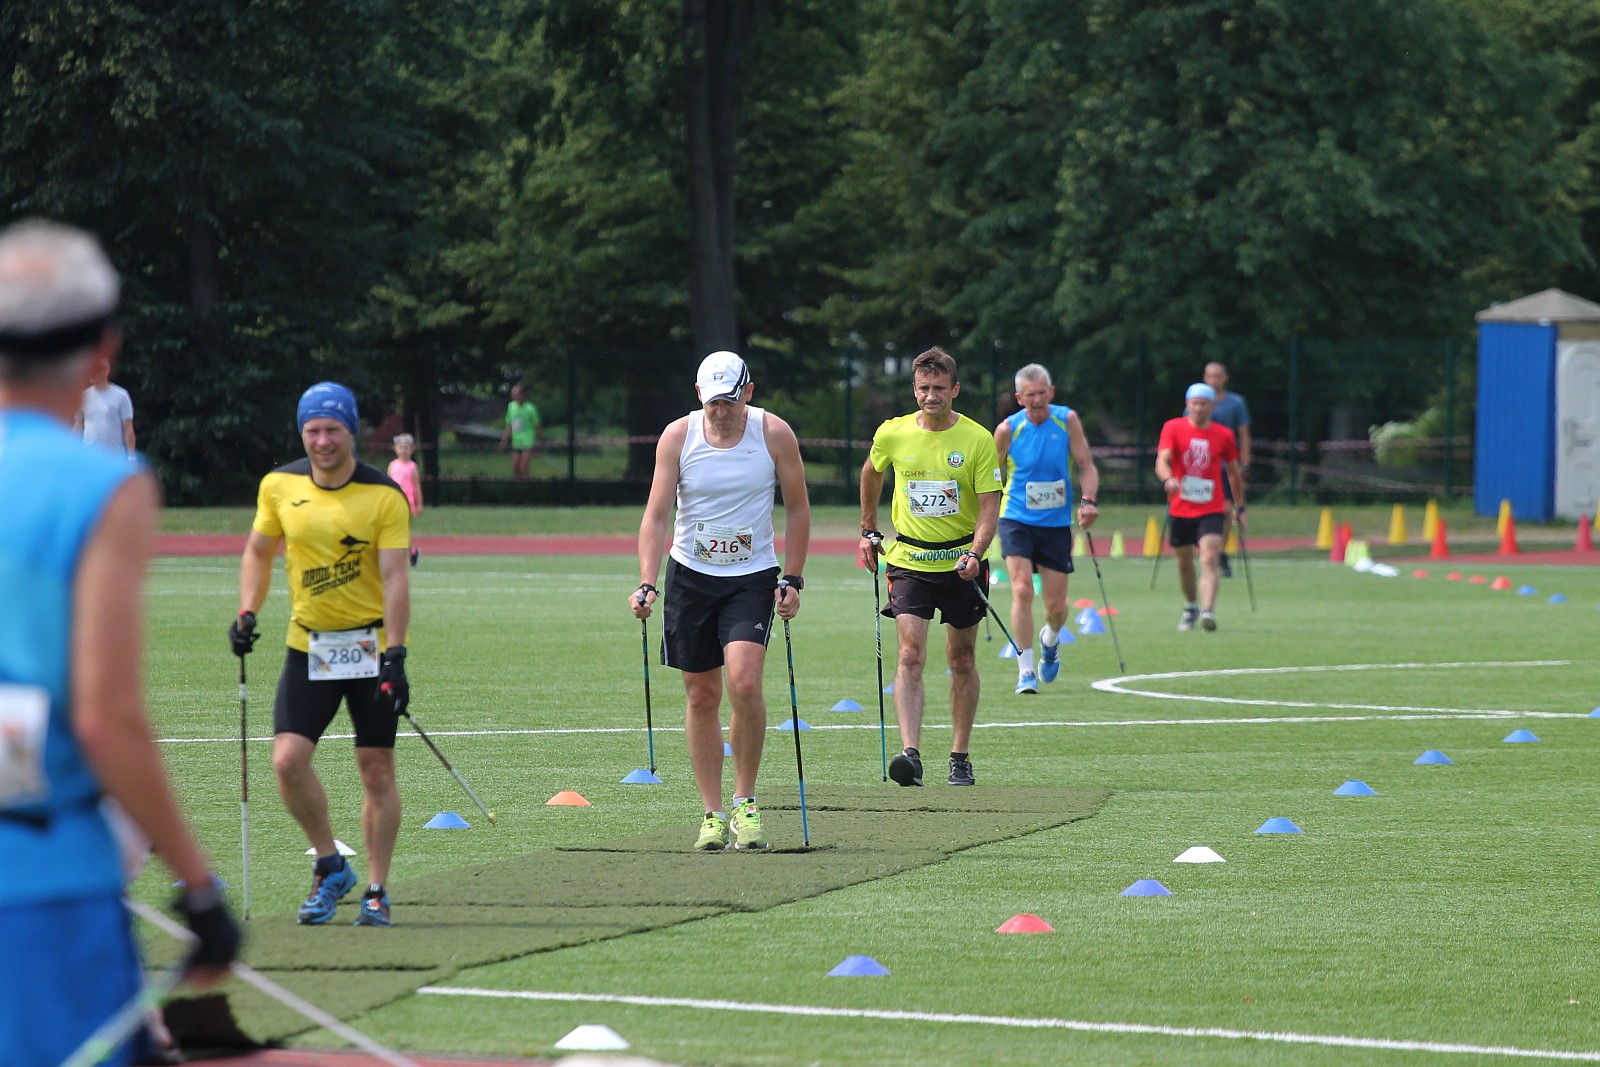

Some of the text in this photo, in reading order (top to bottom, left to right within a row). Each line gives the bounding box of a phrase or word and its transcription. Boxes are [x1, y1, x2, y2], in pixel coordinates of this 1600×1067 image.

[921, 495, 947, 507] 272
[709, 539, 739, 554] 216
[327, 647, 362, 665] 280
